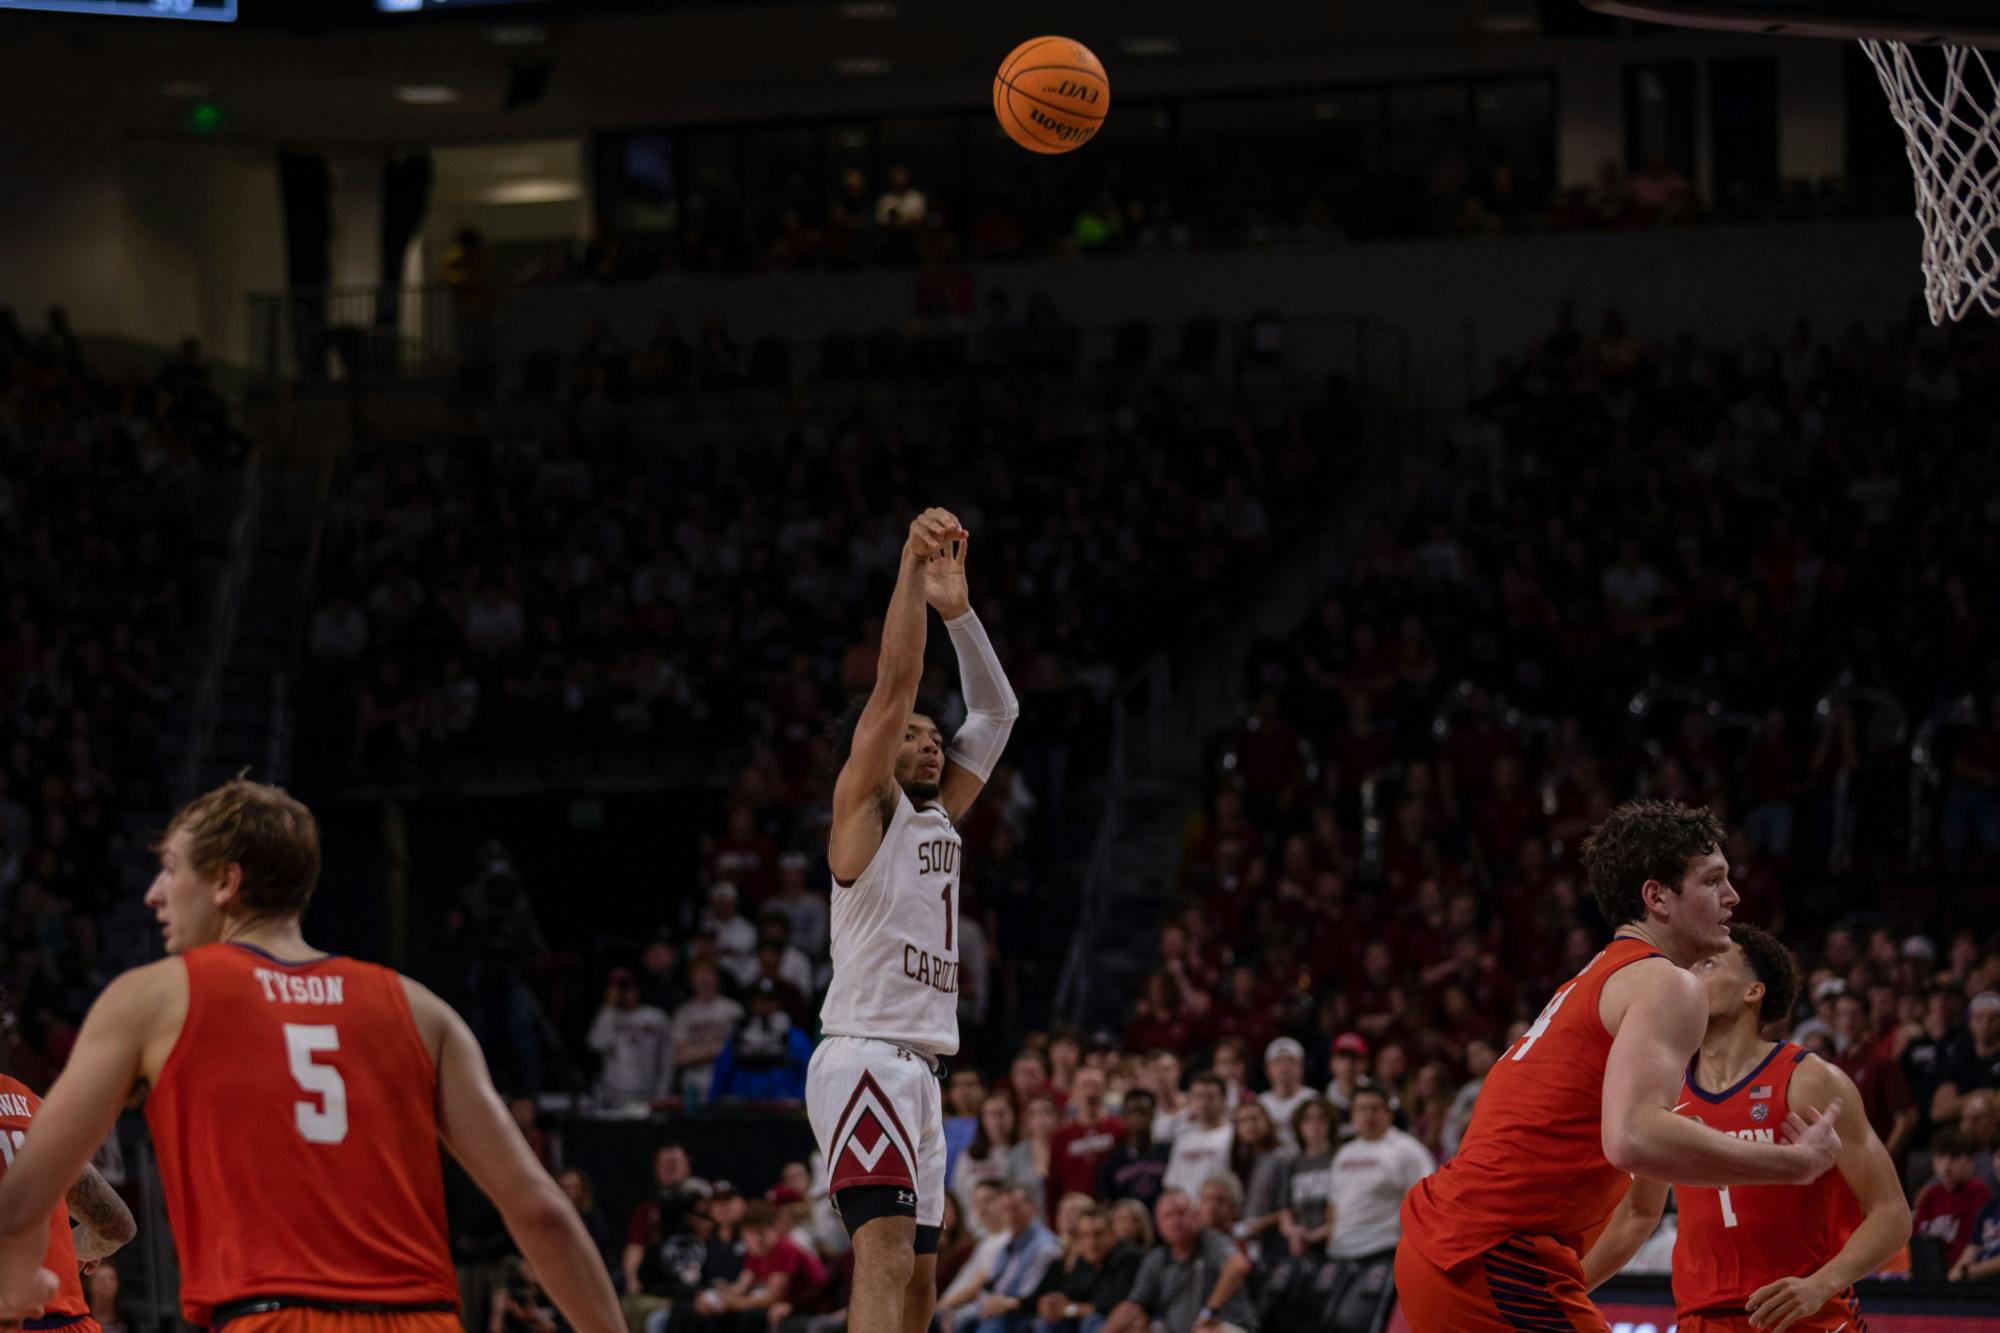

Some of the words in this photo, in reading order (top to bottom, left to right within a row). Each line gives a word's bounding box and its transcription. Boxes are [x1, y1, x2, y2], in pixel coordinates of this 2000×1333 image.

[1030, 109, 1096, 143] Wilson
[941, 882, 953, 951] 1
[253, 966, 344, 1006] TYSON
[282, 1022, 350, 1147] 5
